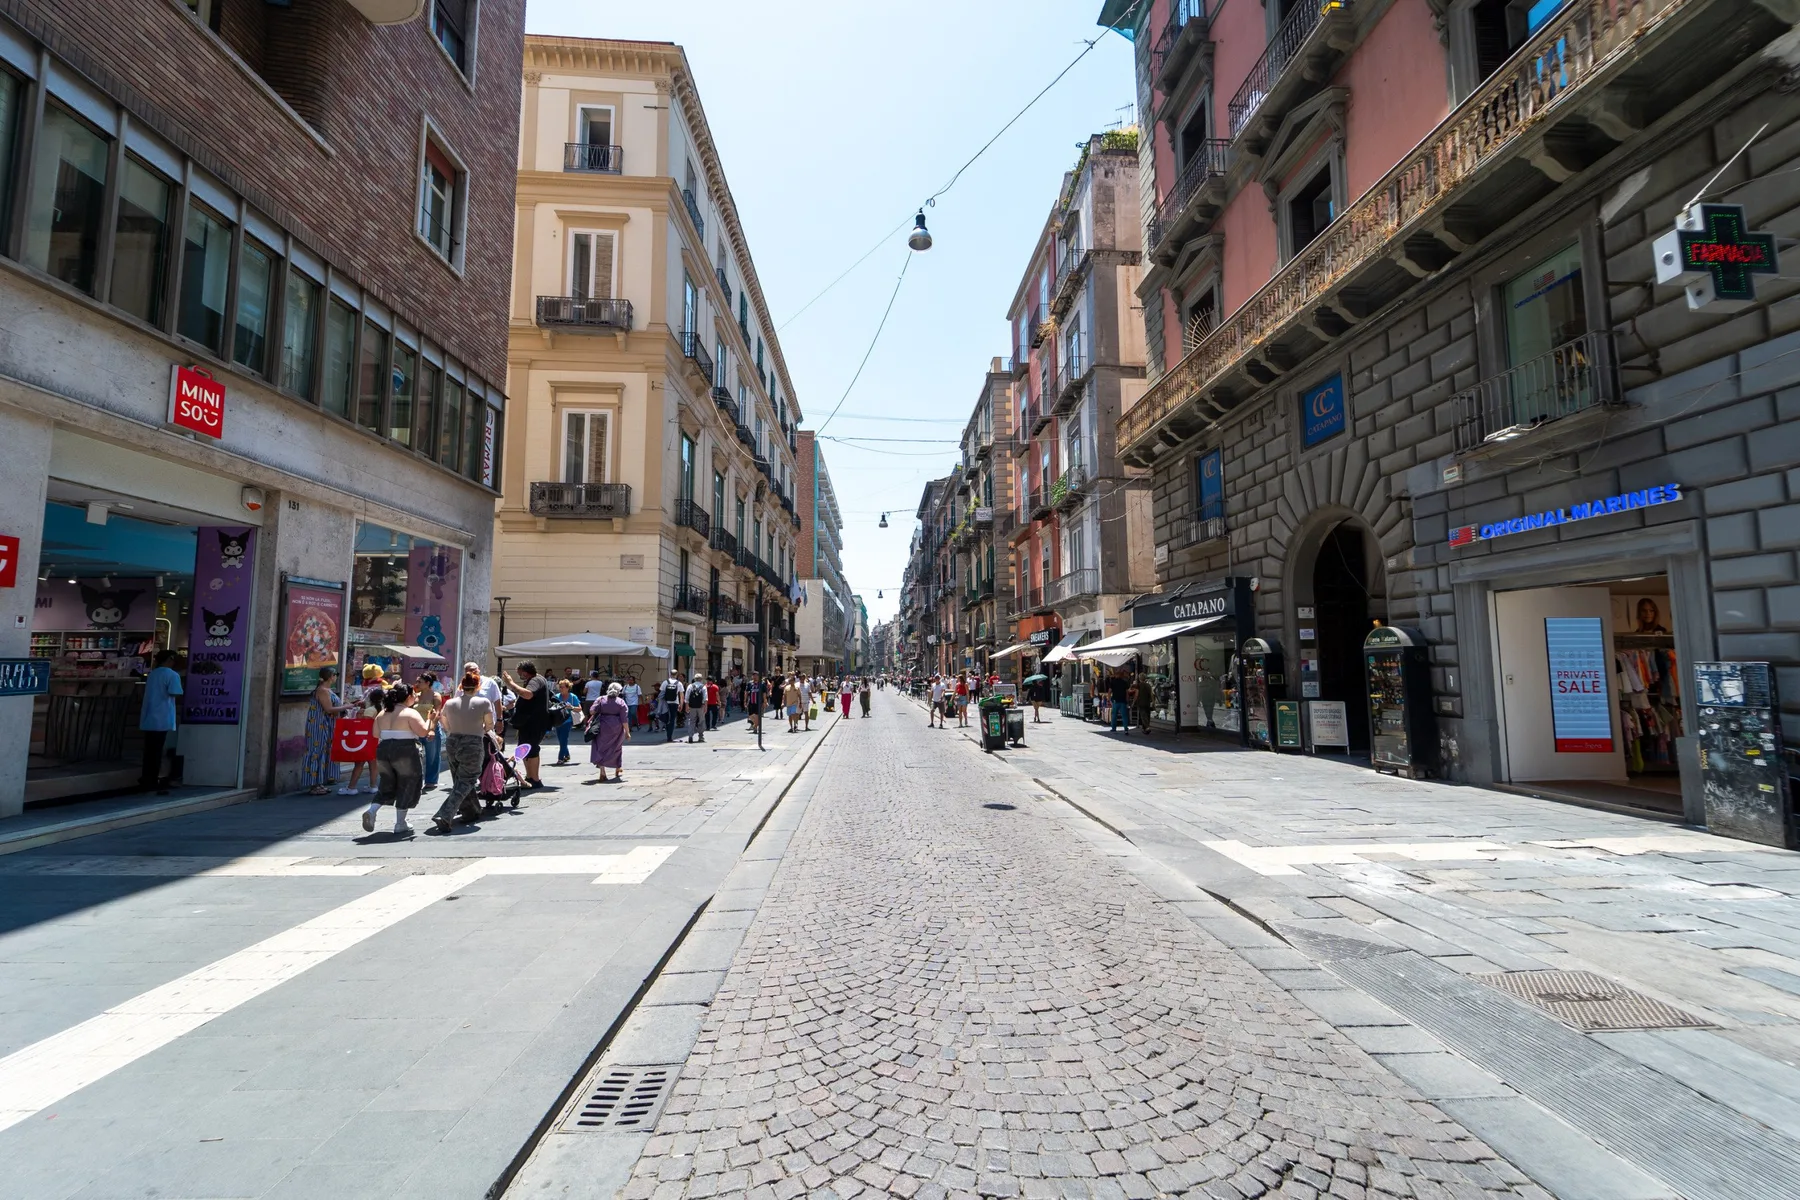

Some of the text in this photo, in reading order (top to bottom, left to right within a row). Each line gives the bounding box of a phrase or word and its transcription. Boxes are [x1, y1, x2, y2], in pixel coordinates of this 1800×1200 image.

[1690, 243, 1765, 263] FARMACIA
[182, 380, 220, 408] MINI
[1307, 412, 1343, 436] CATAPANO
[484, 425, 492, 481] RE/MAX
[288, 499, 300, 511] 131
[1479, 483, 1683, 540] ORIGINAL MARINES
[1173, 597, 1225, 619] CATAPANO
[1030, 631, 1049, 642] SNEAKERS
[193, 652, 240, 662] KUROMI
[1557, 670, 1600, 679] PRIVATE
[1558, 680, 1602, 693] SALE
